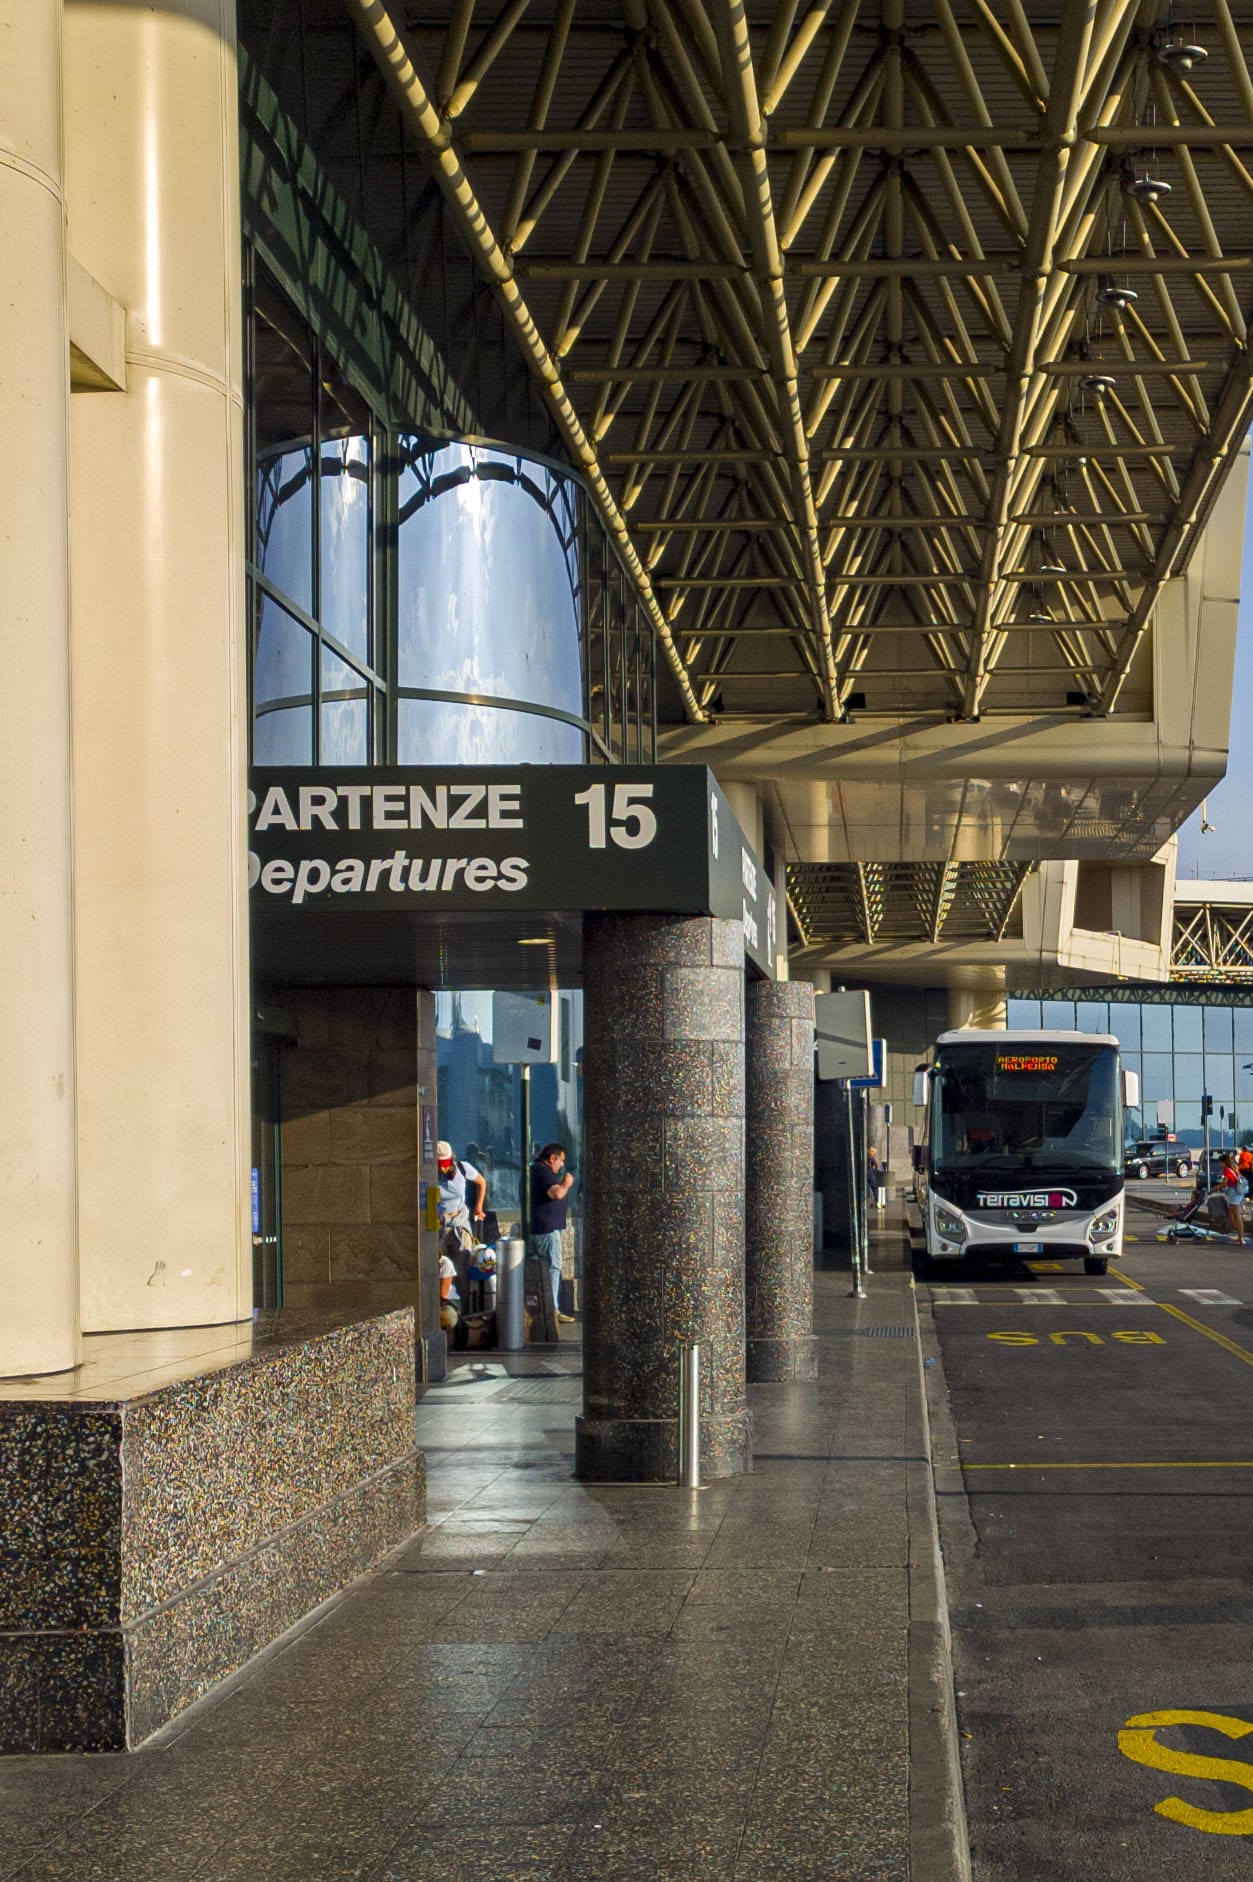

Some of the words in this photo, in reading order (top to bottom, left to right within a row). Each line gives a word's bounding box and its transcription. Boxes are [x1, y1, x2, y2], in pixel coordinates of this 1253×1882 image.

[248, 784, 524, 831] ARTENZE
[574, 783, 658, 850] 15
[986, 1331, 1167, 1346] BUS
